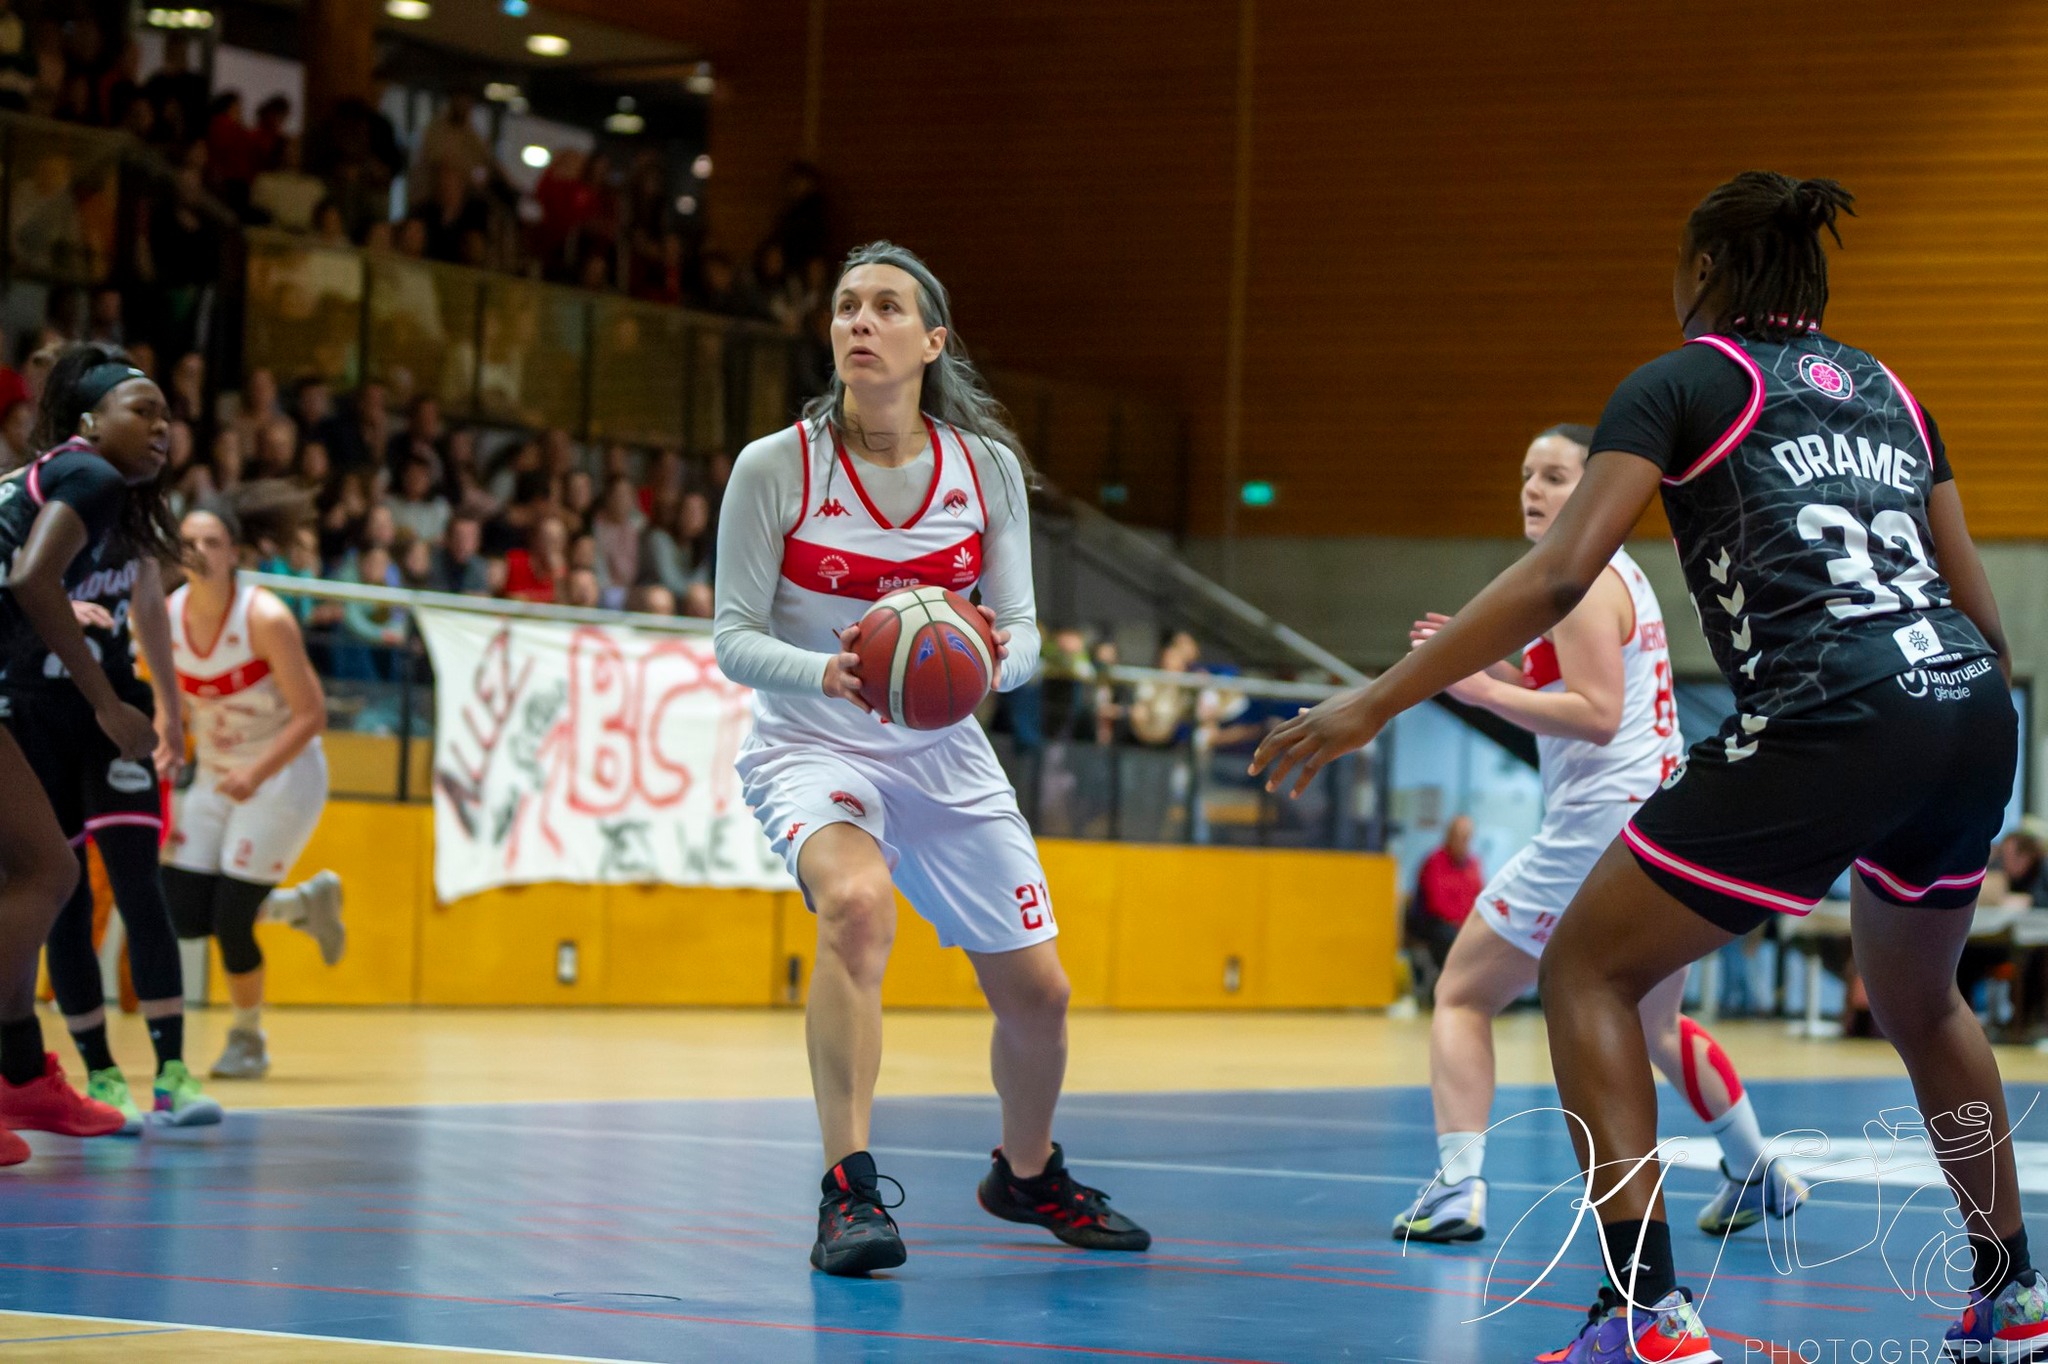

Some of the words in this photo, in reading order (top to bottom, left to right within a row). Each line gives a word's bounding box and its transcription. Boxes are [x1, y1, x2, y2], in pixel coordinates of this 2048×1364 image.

[1771, 433, 1917, 494] DRAME
[879, 576, 920, 589] isère
[1796, 503, 1952, 620] 32
